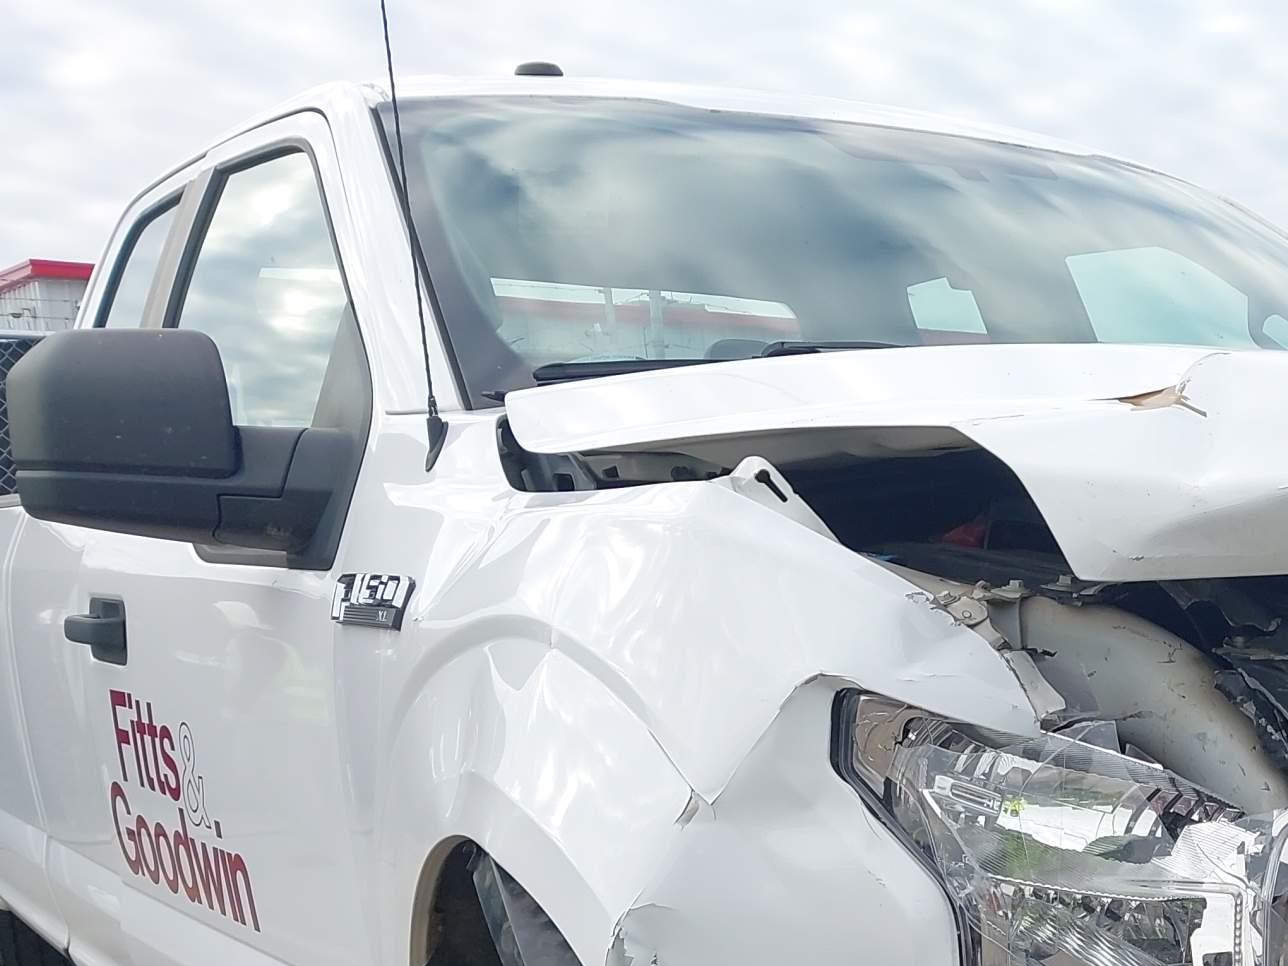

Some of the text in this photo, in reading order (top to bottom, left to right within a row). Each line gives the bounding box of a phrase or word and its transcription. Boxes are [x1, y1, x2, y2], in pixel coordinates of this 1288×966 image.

[109, 689, 212, 828] Fitts &
[110, 781, 261, 933] Goodwin
